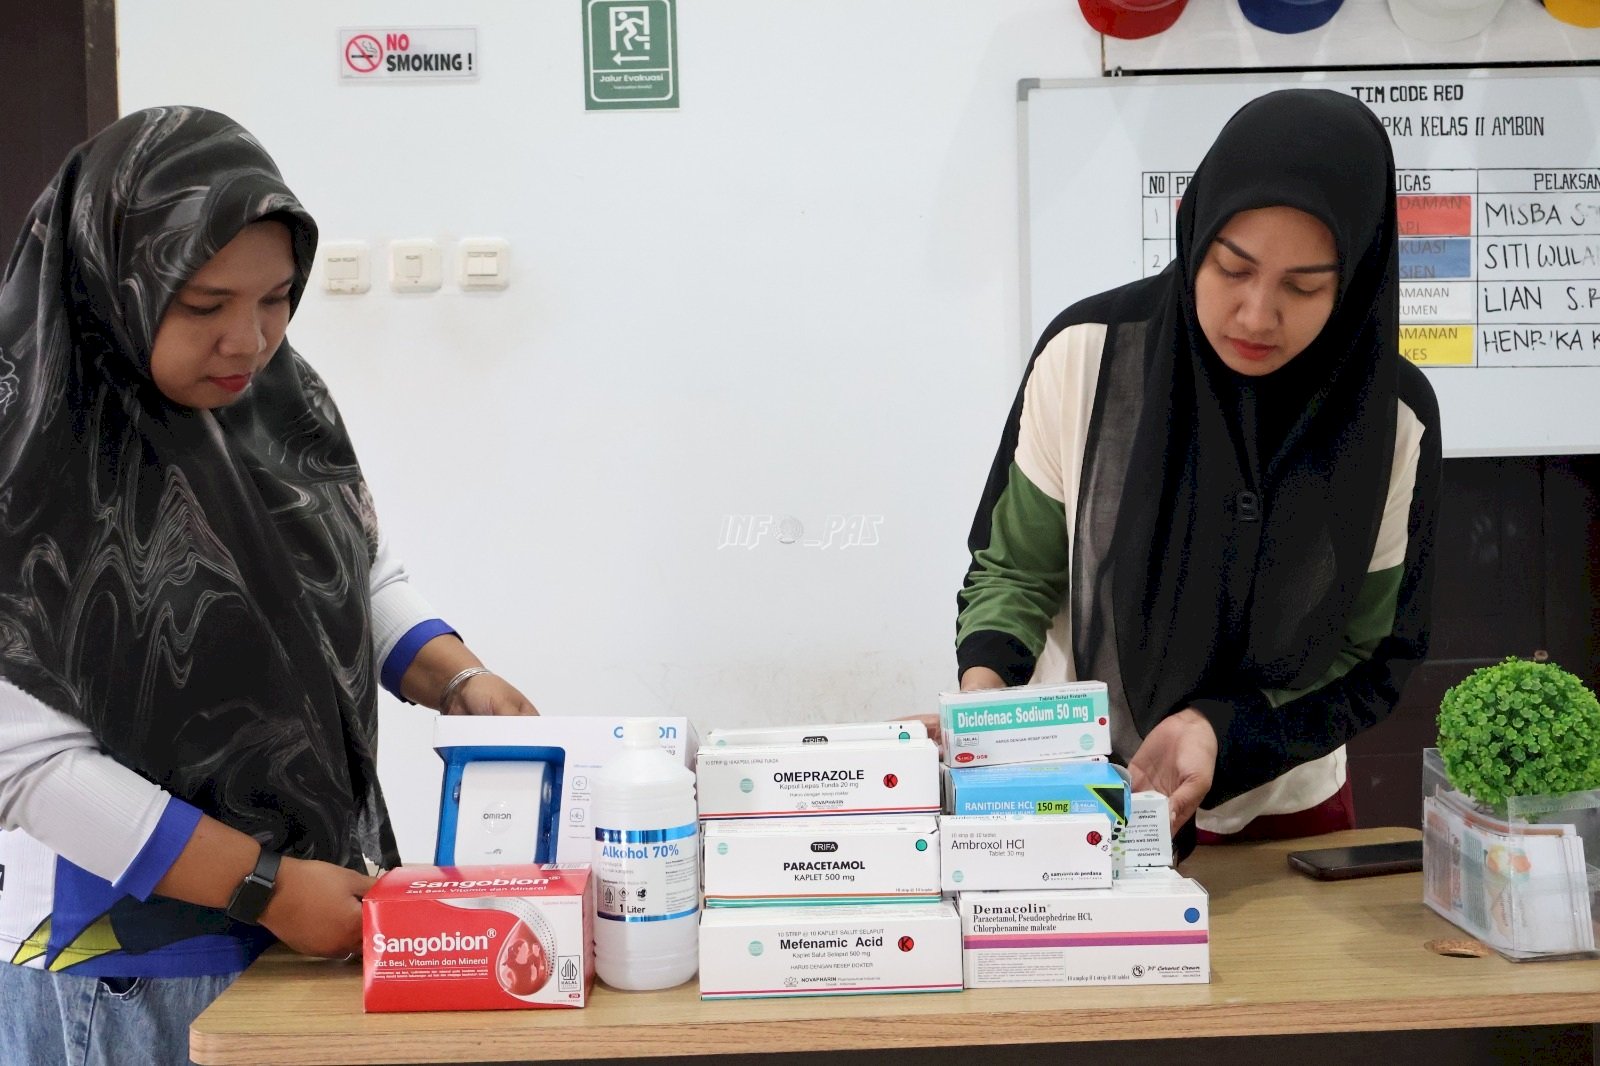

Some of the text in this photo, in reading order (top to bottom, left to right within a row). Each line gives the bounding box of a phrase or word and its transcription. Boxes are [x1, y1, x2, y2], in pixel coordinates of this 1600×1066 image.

[386, 33, 410, 51] NO
[386, 53, 463, 72] SMOKING
[599, 73, 664, 82] Jalur Evakuasi
[1351, 84, 1464, 103] TIM CODE RED
[1421, 116, 1469, 137] KELAS
[1475, 116, 1485, 136] II
[1492, 116, 1544, 136] AMBON
[1149, 175, 1165, 194] NO
[1485, 201, 1562, 228] MISBA
[1152, 254, 1161, 267] 2
[1485, 243, 1529, 269] SITI
[1484, 286, 1542, 312] LIAN
[1399, 304, 1438, 316] UMEN
[957, 703, 1089, 729] Diclofenac Sodium 50 mg
[773, 769, 865, 783] OMEPRAZOLE
[779, 783, 800, 791] Kapsul
[801, 782, 820, 790] Lepas
[965, 801, 1069, 813] RANITIDINE HCL 150 mg
[813, 843, 836, 851] TRIFA
[951, 838, 1025, 850] Ambroxol HCl
[602, 843, 679, 859] Alkohol 70%
[783, 860, 866, 871] PARACETAMOL
[824, 873, 841, 881] 500
[842, 874, 855, 882] mg
[619, 904, 646, 913] 1 Liter
[973, 903, 1047, 915] Demacolin
[973, 914, 1017, 924] Paracetamol,
[1018, 913, 1076, 923] Pseudoephedrine
[973, 923, 1057, 934] Chlorphenamine maleate
[780, 936, 883, 950] Mefenamic Acid
[374, 956, 488, 968] Zat Besi, Vitamin dan Mineral
